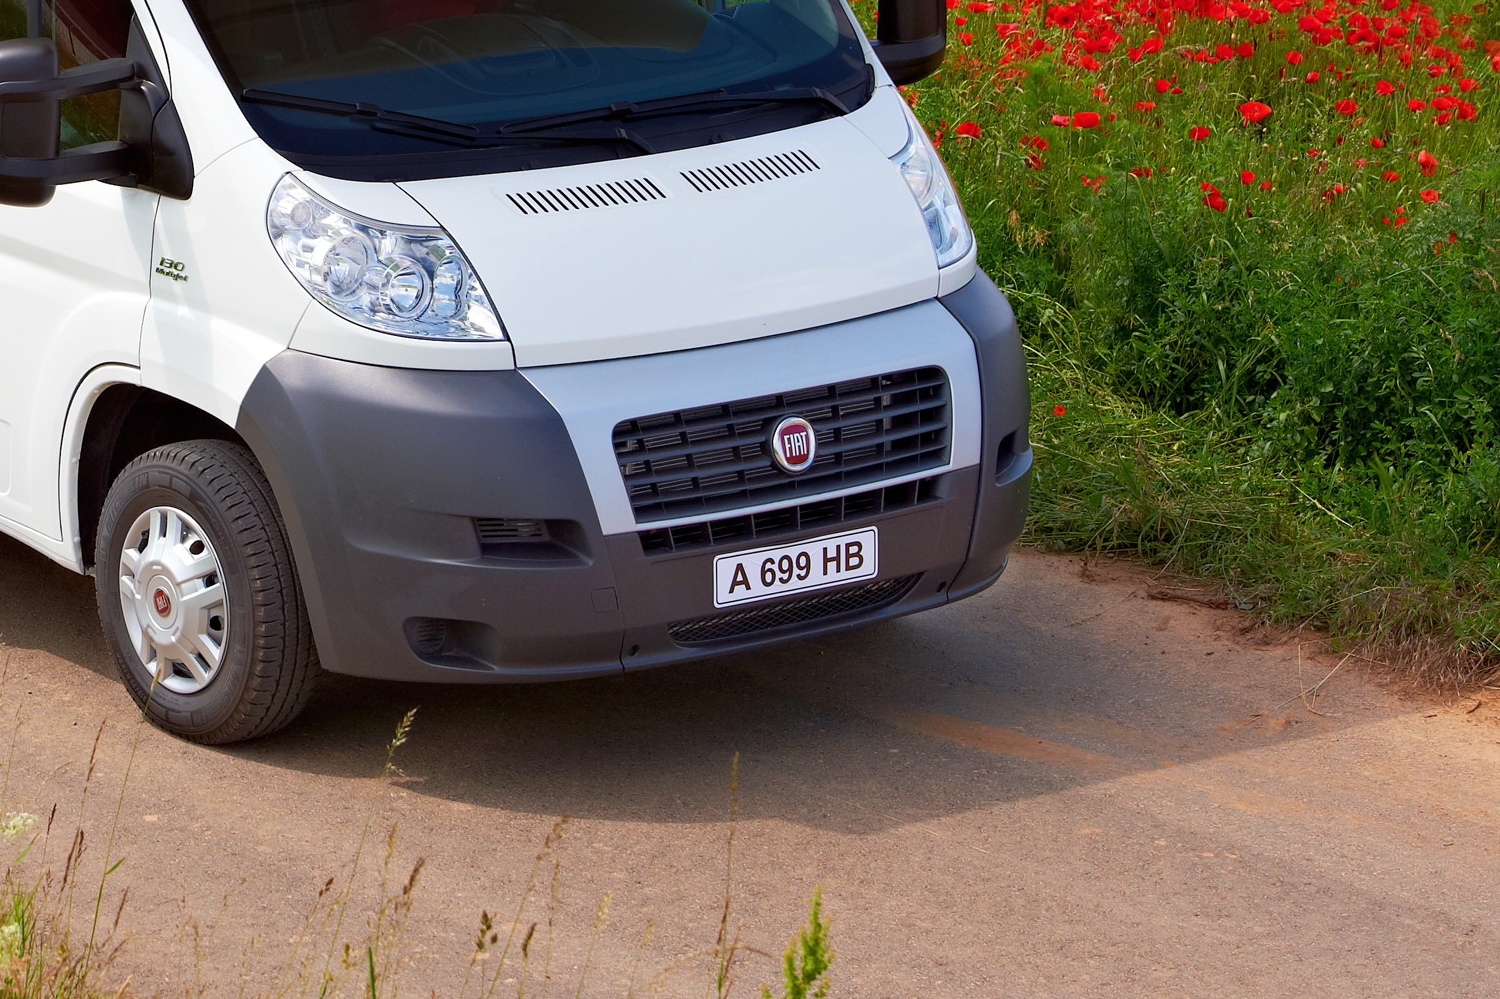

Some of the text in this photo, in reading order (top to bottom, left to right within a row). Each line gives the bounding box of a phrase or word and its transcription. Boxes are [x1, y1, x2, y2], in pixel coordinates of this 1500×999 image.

[159, 257, 185, 272] 130
[783, 431, 807, 458] FIAT
[727, 540, 865, 595] A 699 HB
